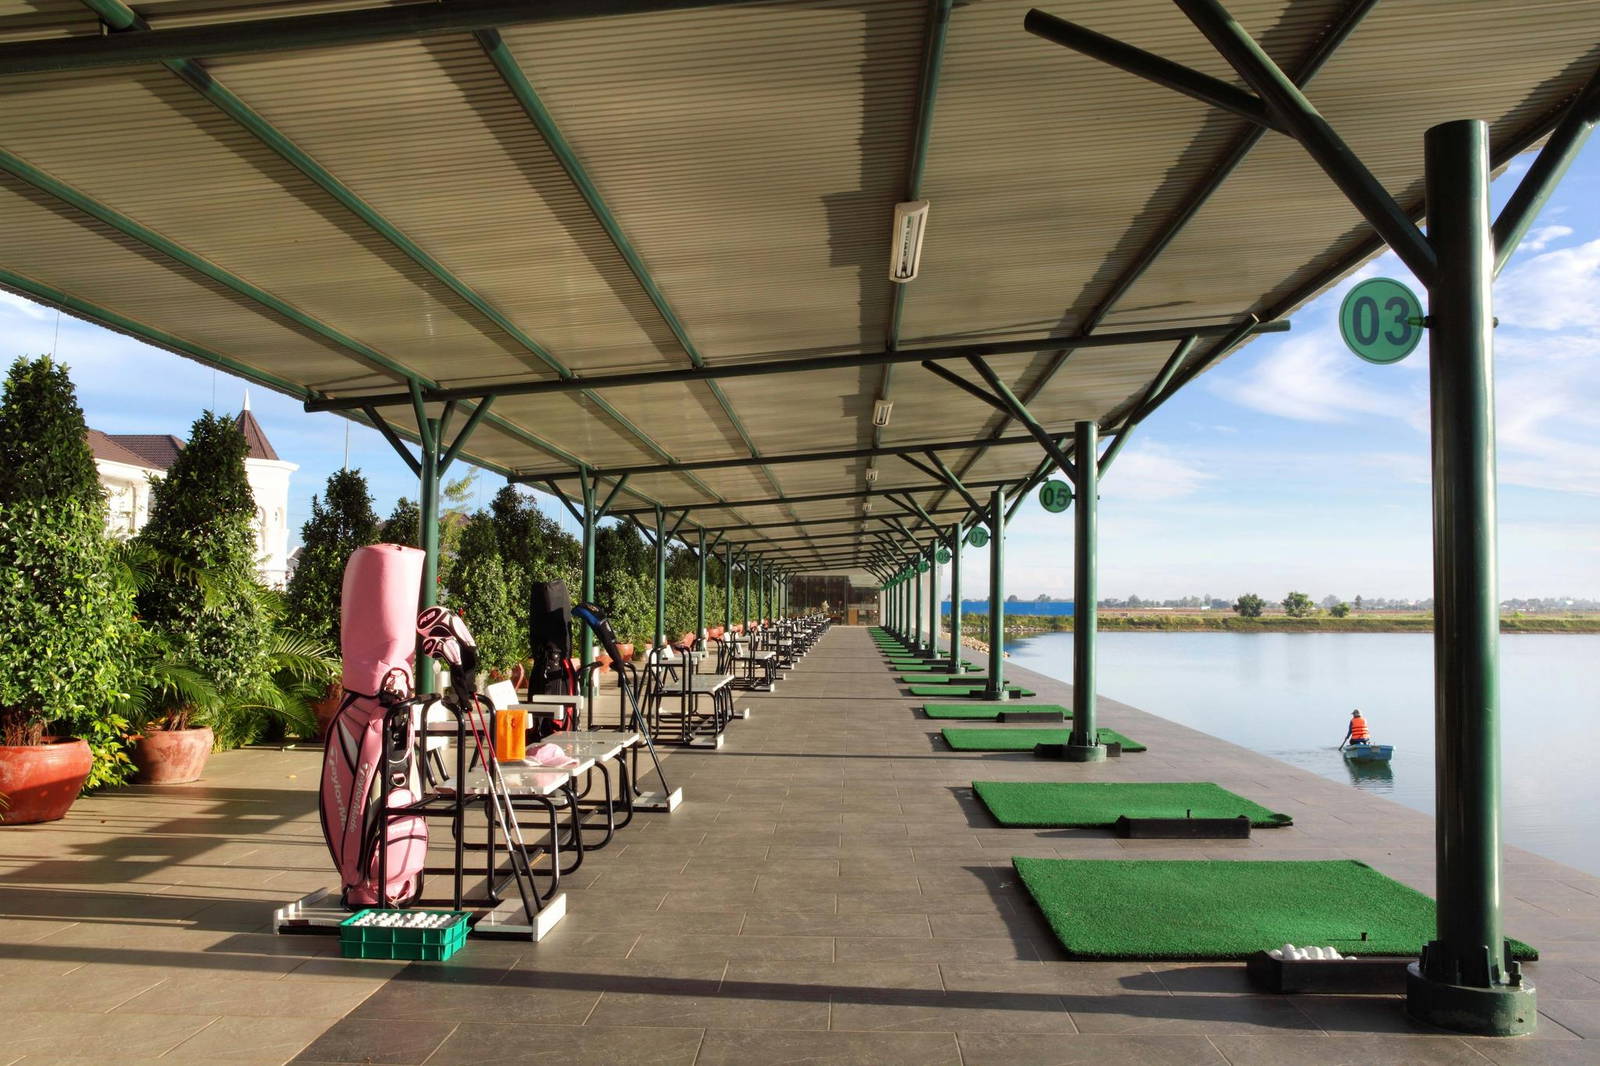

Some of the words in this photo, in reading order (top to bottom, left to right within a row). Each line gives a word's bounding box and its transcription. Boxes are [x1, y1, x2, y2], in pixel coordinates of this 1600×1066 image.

[1353, 296, 1411, 346] 03
[1043, 488, 1066, 507] 05
[971, 532, 985, 544] 07
[938, 552, 949, 561] 09
